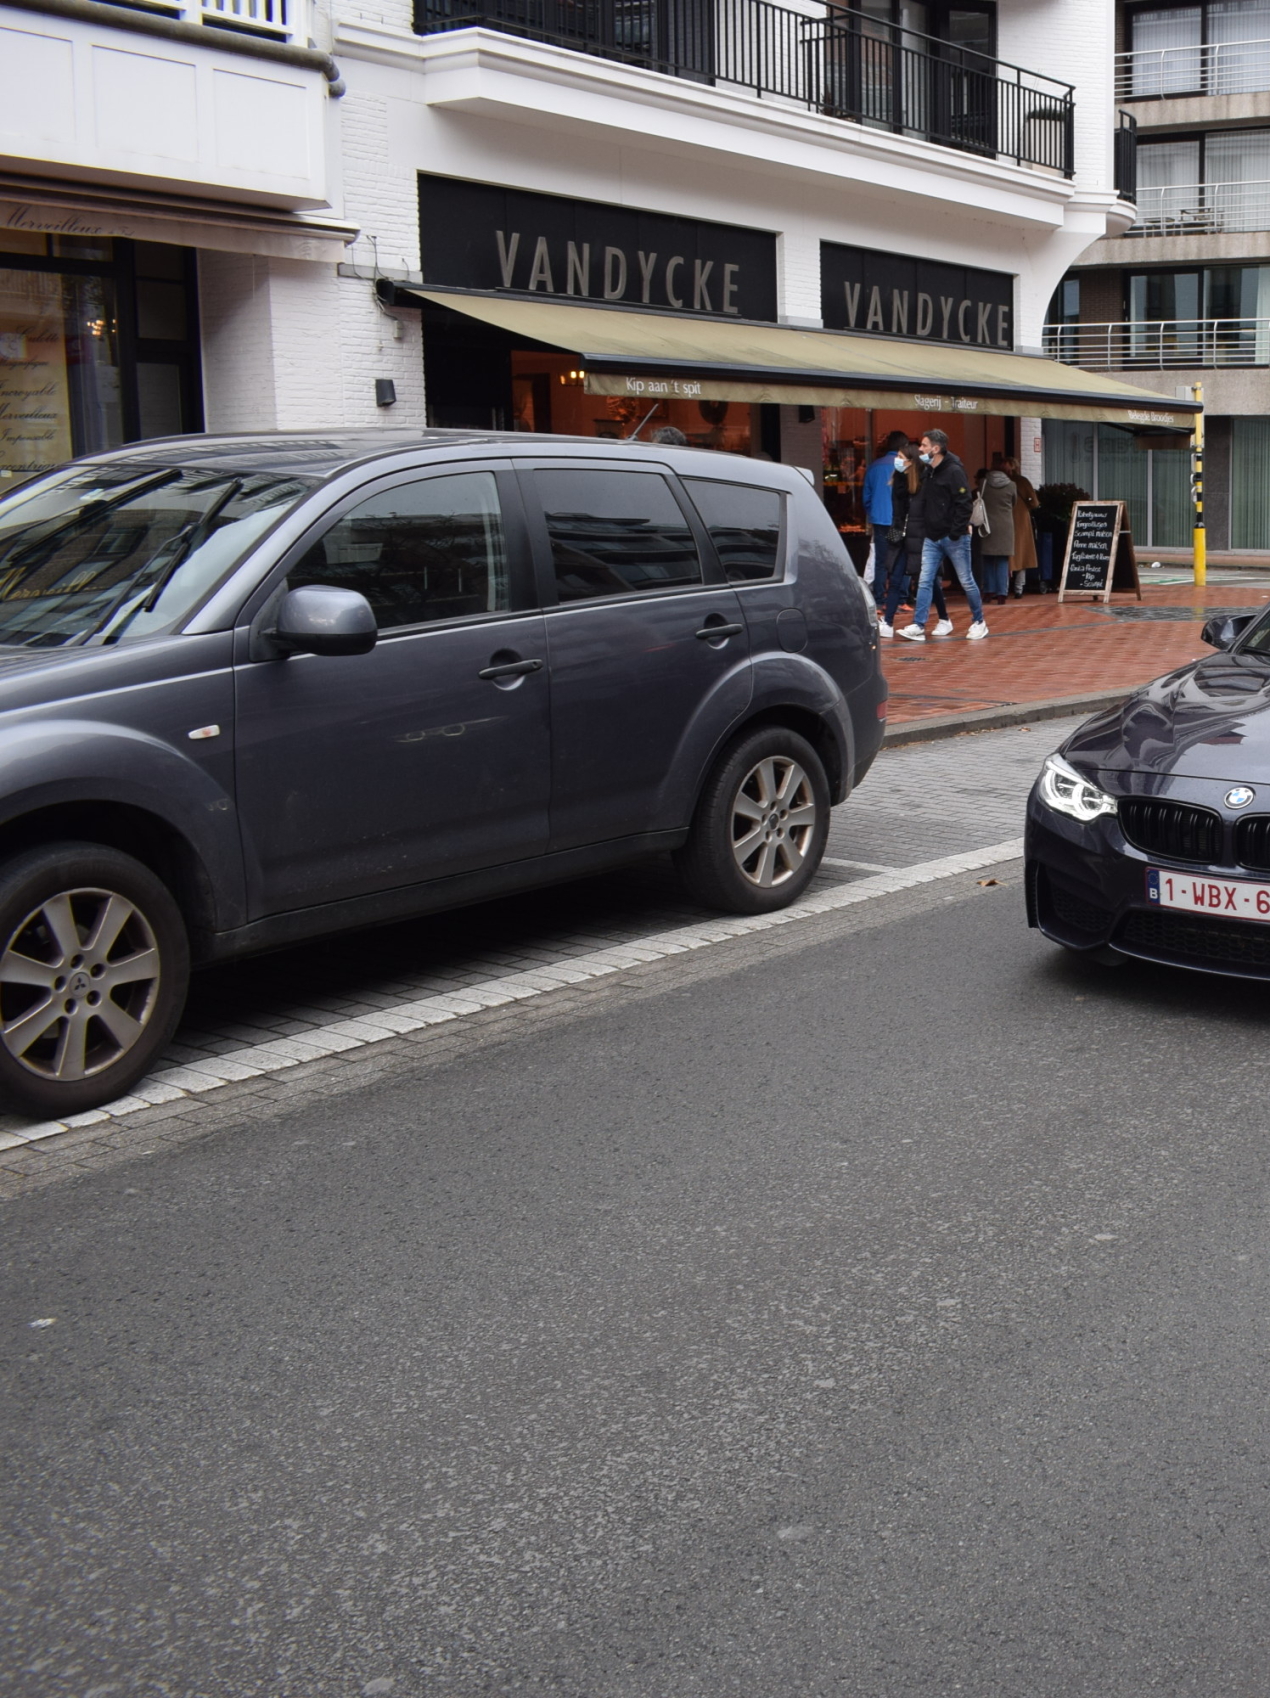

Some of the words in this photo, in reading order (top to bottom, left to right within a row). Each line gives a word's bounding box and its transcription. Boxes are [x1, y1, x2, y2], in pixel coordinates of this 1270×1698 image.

[496, 230, 740, 314] VANDYCKE
[844, 281, 1009, 346] VANDYCKE
[626, 377, 645, 395] Kip
[648, 381, 668, 393] aan
[682, 381, 702, 398] spit
[914, 394, 942, 411] Slagerij
[951, 396, 979, 410] Traiteur
[1149, 887, 1158, 899] B
